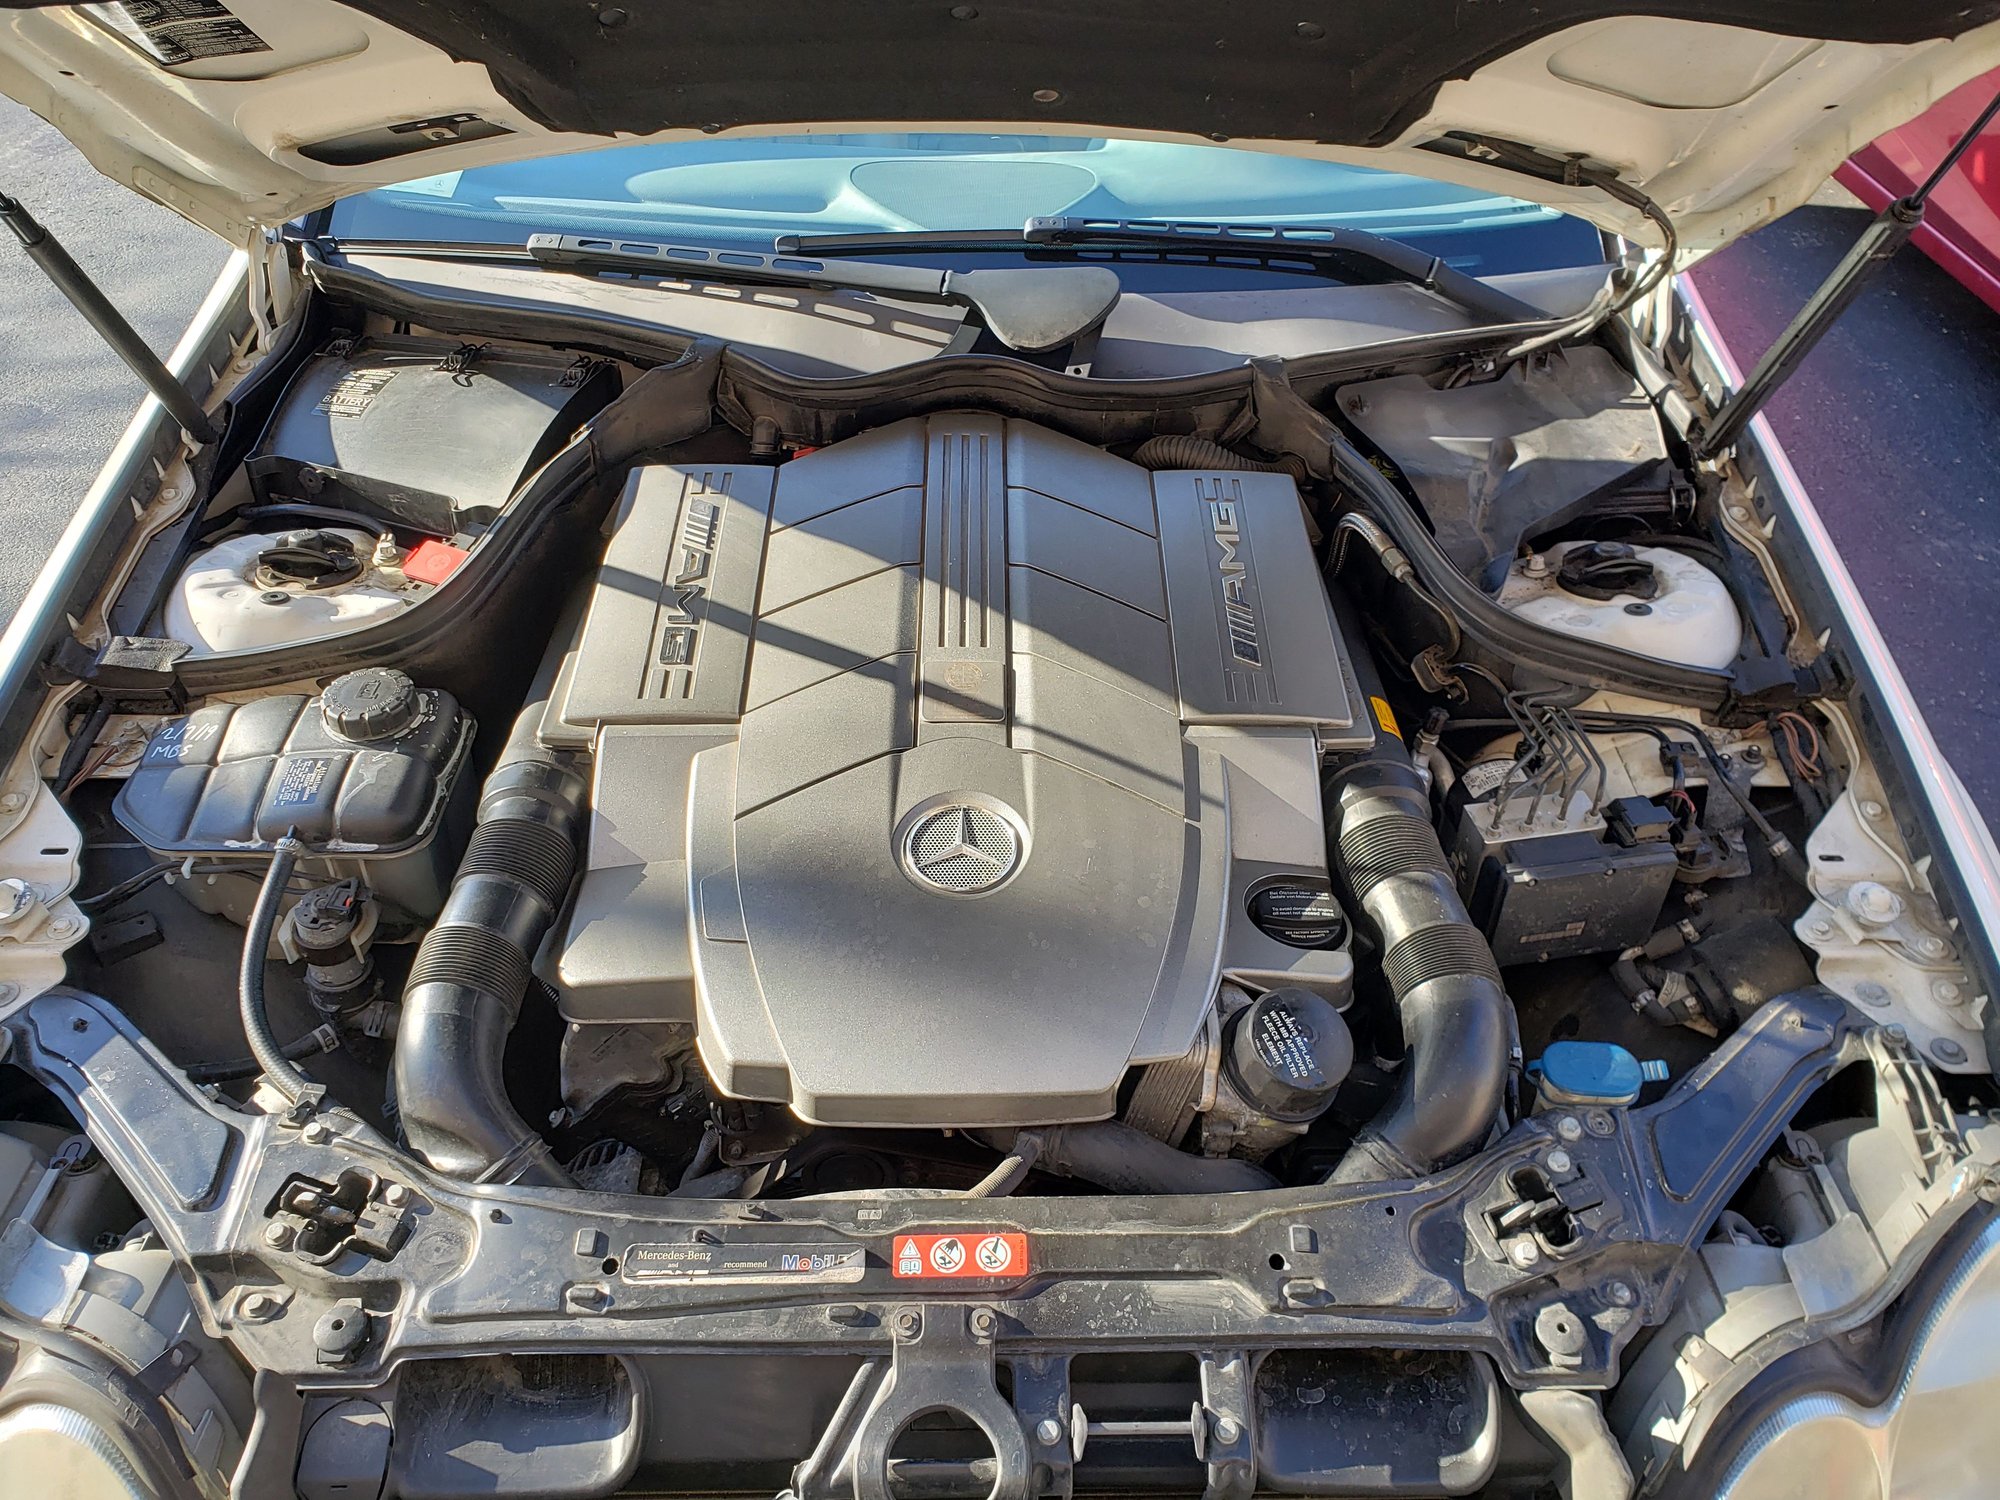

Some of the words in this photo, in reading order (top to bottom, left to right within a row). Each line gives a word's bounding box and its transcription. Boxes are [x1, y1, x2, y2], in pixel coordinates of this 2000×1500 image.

[322, 395, 374, 407] BATTERY
[161, 722, 219, 741] 2/7/19
[1261, 1015, 1281, 1041] FLEECE
[1277, 1041, 1287, 1054] OIL
[1283, 1053, 1299, 1079] FILTER
[1261, 1033, 1284, 1065] ELEMENT
[1269, 1010, 1283, 1028] WITH
[1279, 1027, 1289, 1039] MB
[1285, 1039, 1308, 1077] APPROVED
[1279, 1011, 1299, 1037] ALWAYS
[1295, 1036, 1315, 1070] REPLACE
[637, 1250, 712, 1263] Mercedes-Benz
[723, 1260, 767, 1269] recommend
[781, 1254, 835, 1270] Mobil
